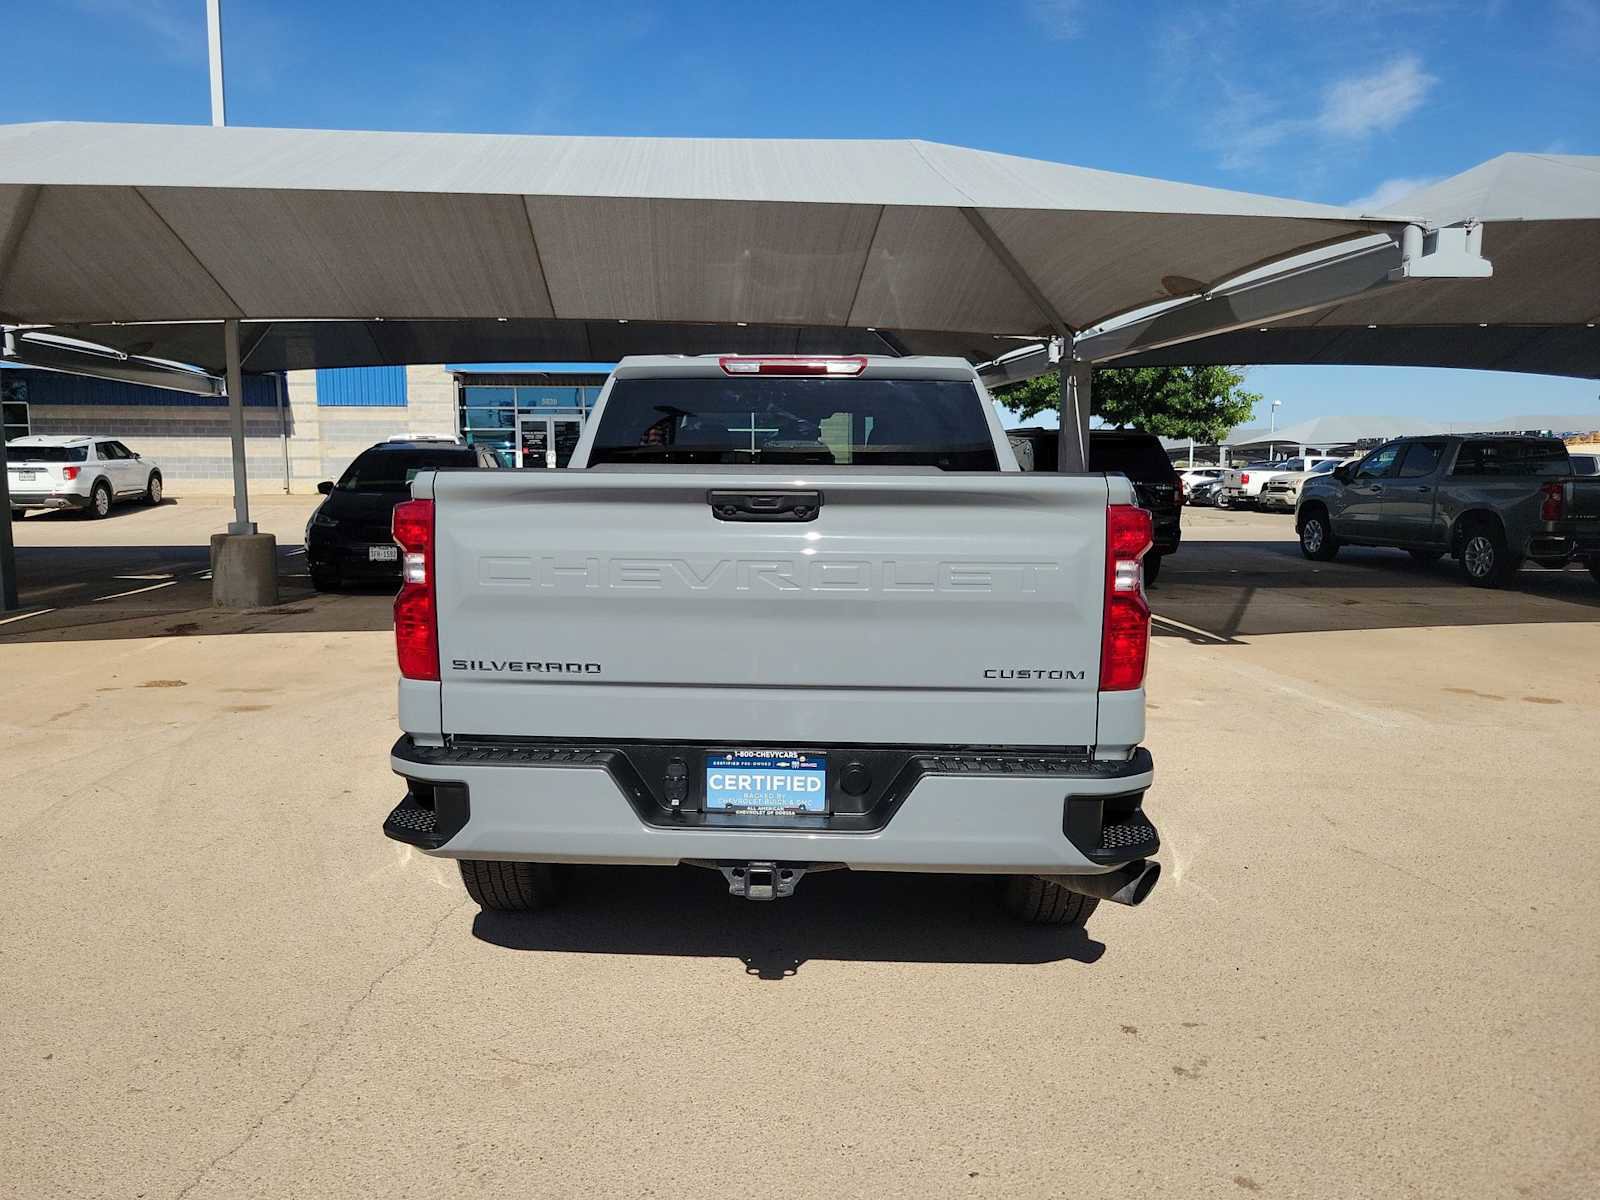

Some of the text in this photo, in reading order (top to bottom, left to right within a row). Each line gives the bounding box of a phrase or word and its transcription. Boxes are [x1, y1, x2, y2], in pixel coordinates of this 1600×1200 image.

[478, 556, 1059, 593] CHEVROLET
[452, 659, 602, 674] SILVERADO
[983, 669, 1086, 680] CUSTOM
[709, 775, 821, 792] CERTIFIED
